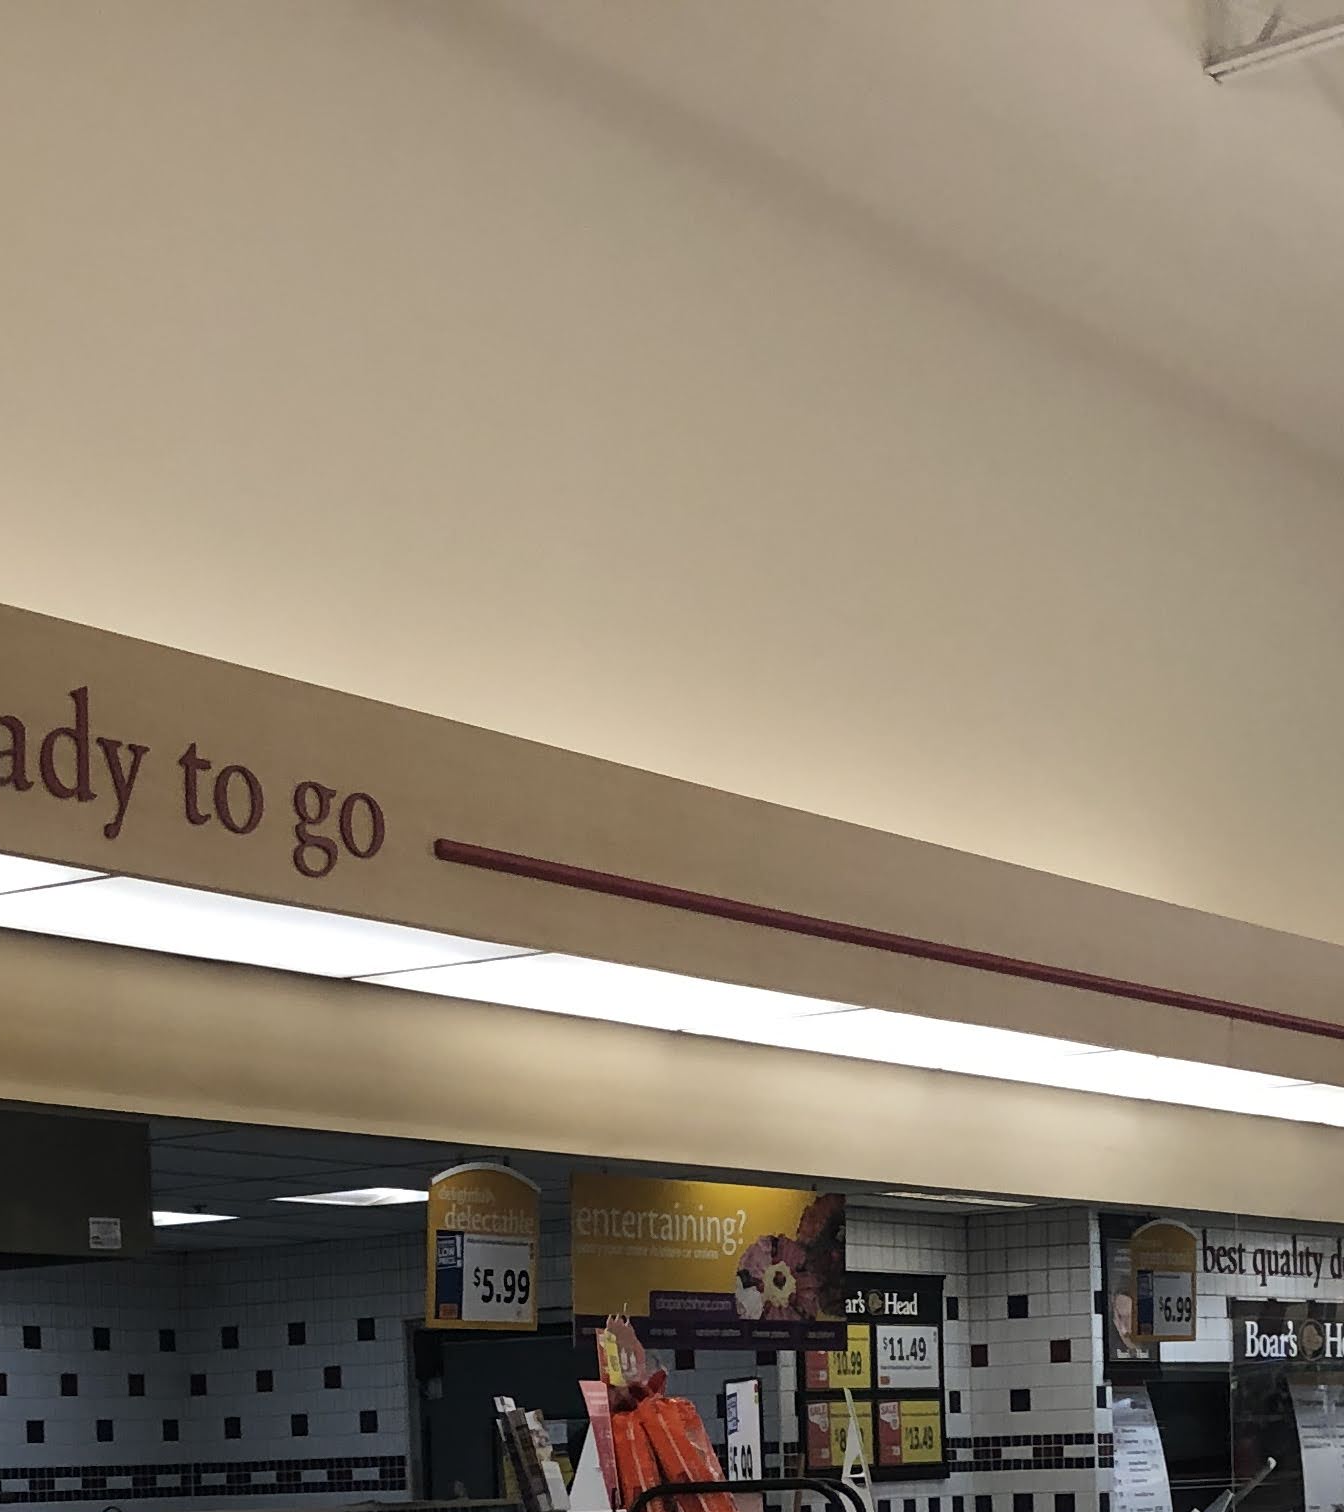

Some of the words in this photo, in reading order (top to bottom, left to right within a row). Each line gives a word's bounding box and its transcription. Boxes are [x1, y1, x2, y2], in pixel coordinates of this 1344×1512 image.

[177, 742, 265, 835] to
[292, 779, 386, 878] go
[575, 1201, 748, 1256] entertaining?
[1202, 1228, 1246, 1274] best
[1252, 1234, 1324, 1288] quality
[473, 1266, 531, 1304] $5.99
[845, 1291, 866, 1314] ar's
[883, 1292, 918, 1316] Head
[1158, 1296, 1193, 1323] $6.99
[882, 1336, 927, 1362] $11.49
[1244, 1319, 1298, 1359] Boar's
